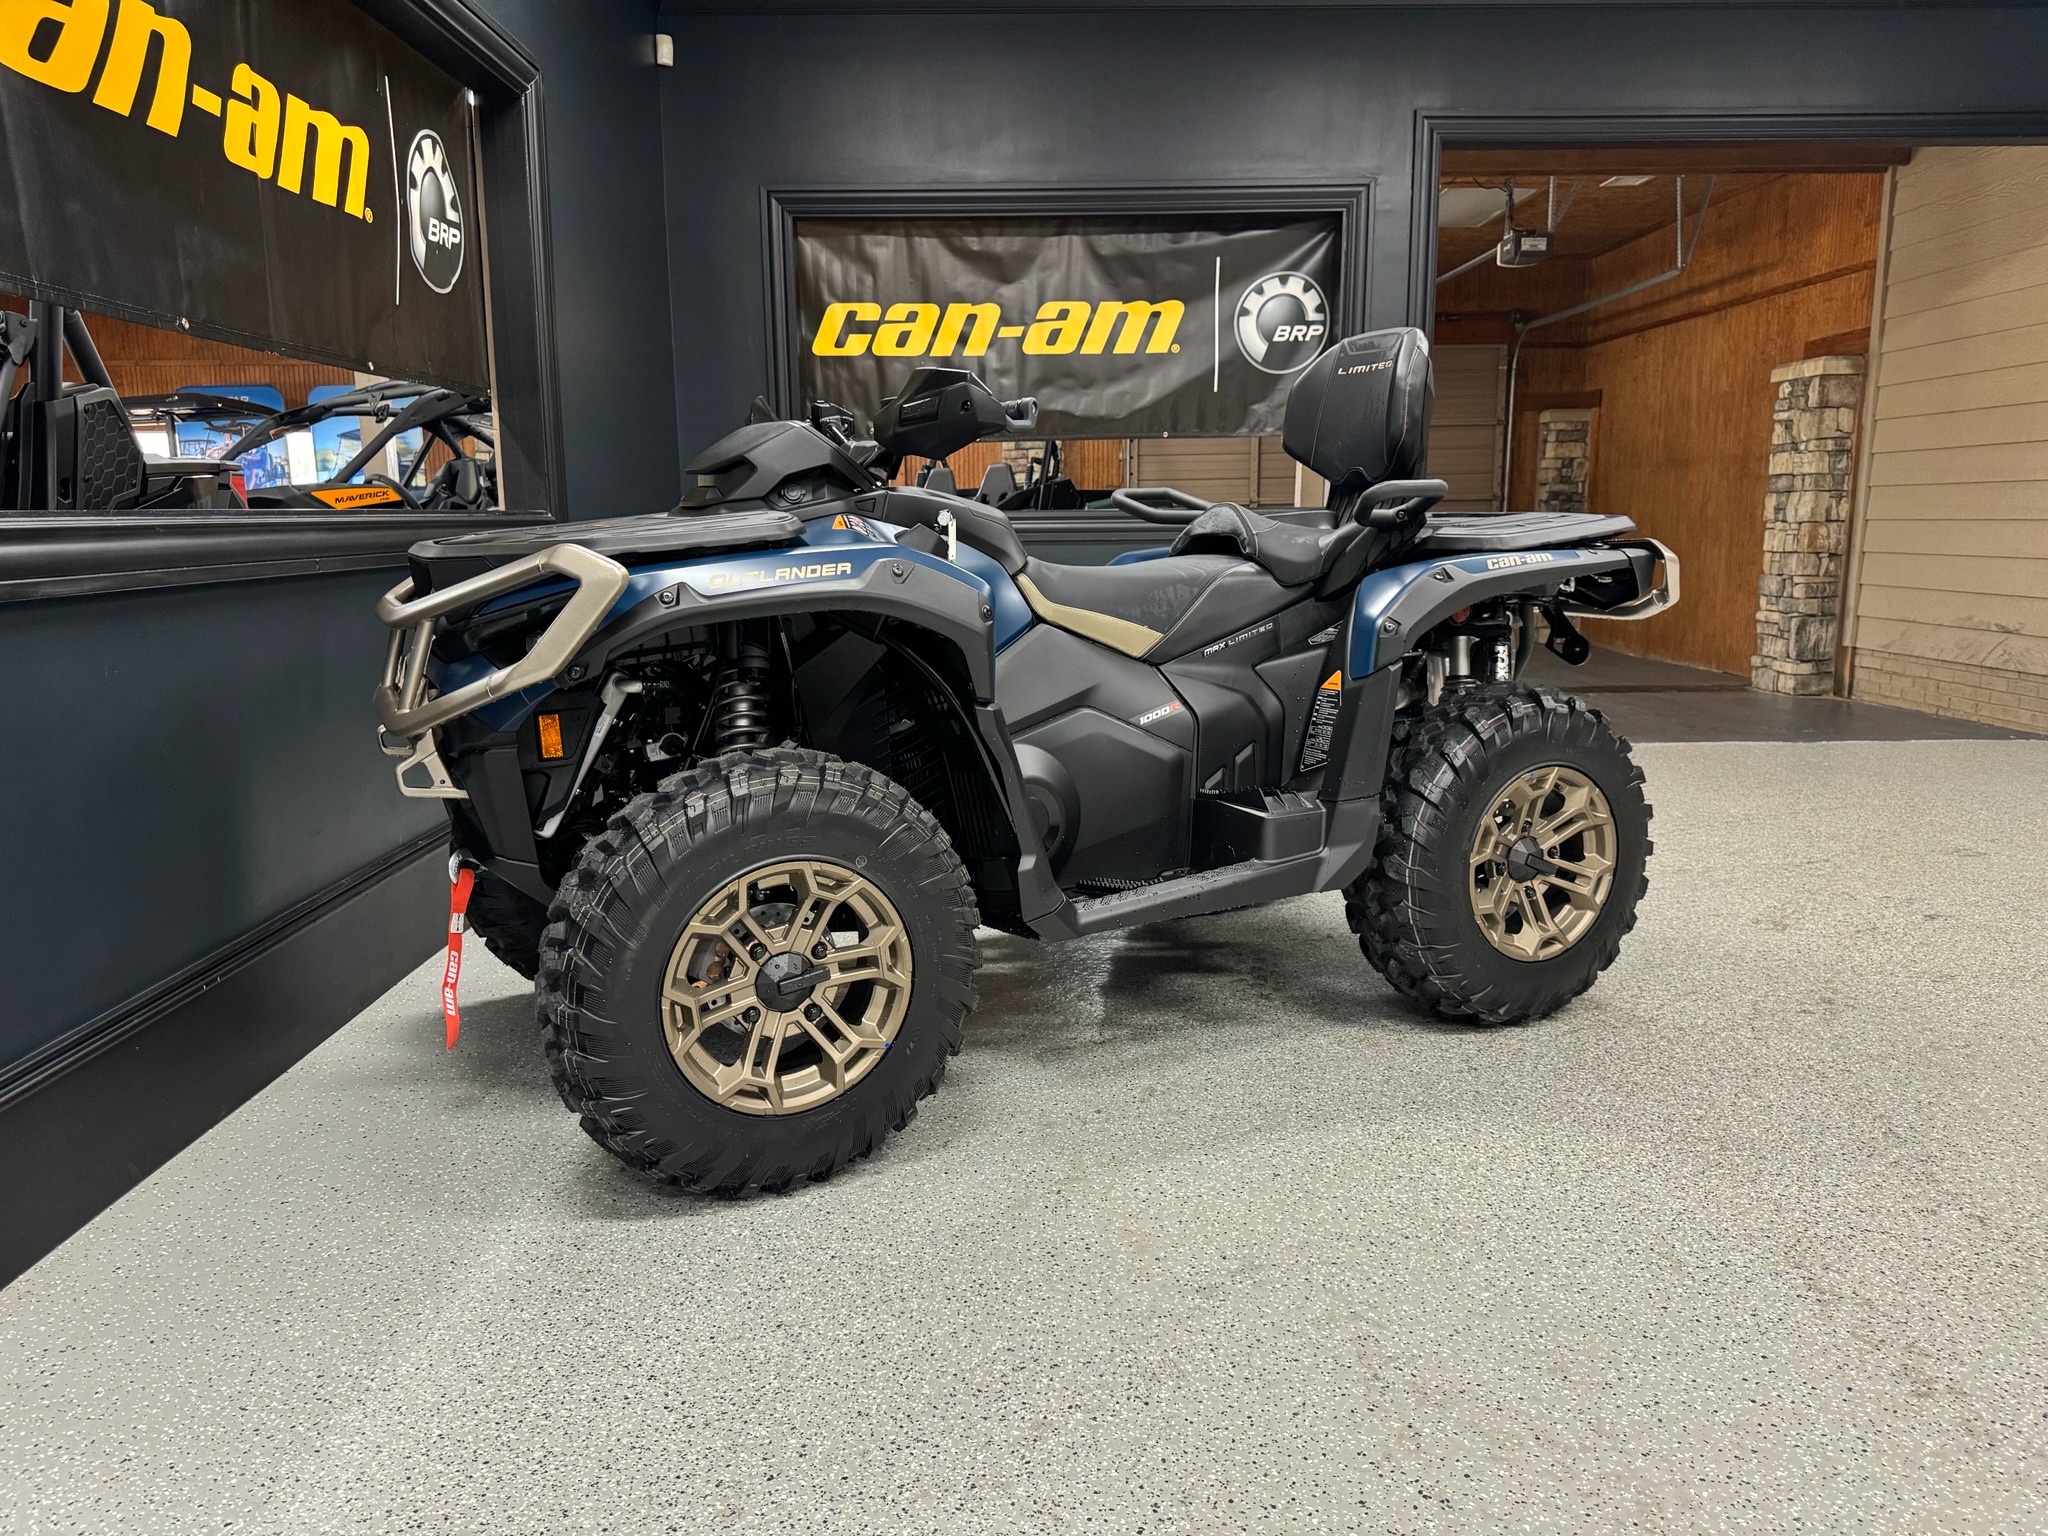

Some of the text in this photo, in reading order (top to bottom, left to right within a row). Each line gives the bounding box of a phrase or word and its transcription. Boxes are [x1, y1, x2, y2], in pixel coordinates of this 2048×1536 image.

[428, 217, 461, 250] BRP
[811, 299, 1185, 357] can-am
[1272, 324, 1324, 343] BRP
[1337, 360, 1393, 375] LIMITED
[334, 490, 390, 504] MAVERICK
[1486, 553, 1553, 570] can-am
[708, 562, 852, 590] OUTLANDER
[1204, 622, 1273, 656] MAX LIMITED
[1494, 645, 1509, 681] FOX
[1139, 701, 1181, 726] 1000R
[443, 950, 459, 1016] can-am
